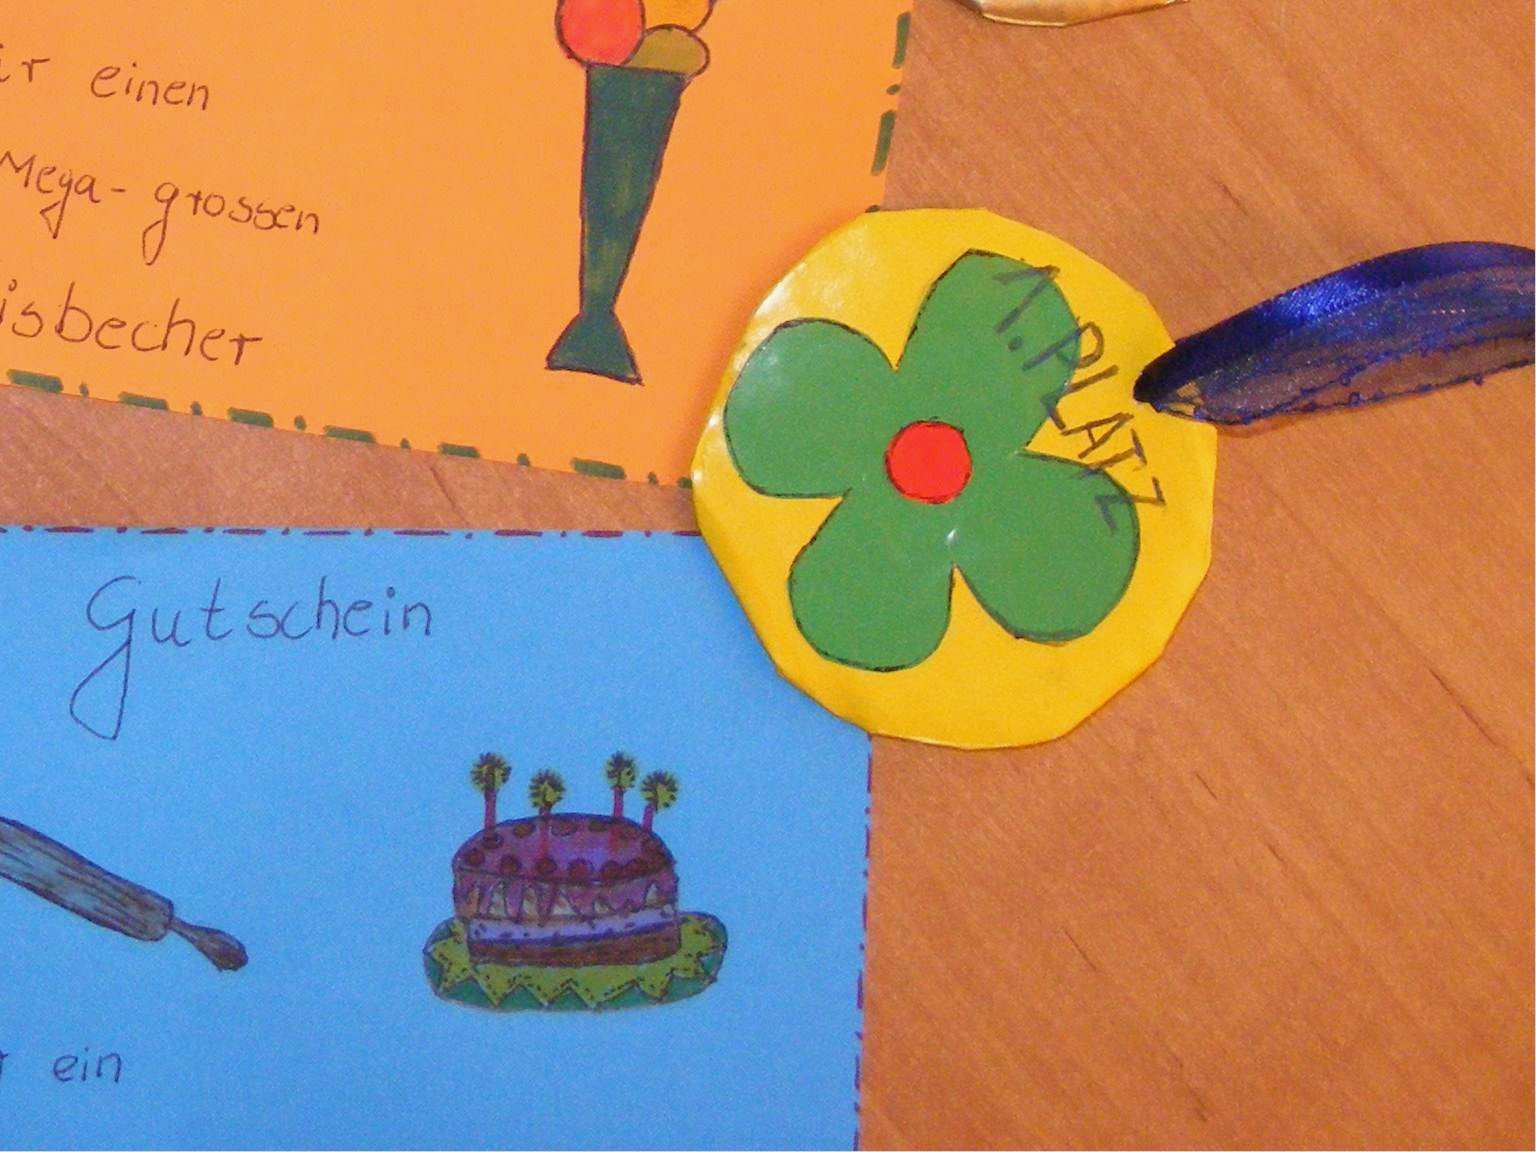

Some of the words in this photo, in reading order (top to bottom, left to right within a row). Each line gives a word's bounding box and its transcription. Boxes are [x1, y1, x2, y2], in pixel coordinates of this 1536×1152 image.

[88, 60, 211, 112] einen
[140, 179, 322, 266] grossen
[68, 574, 435, 741] Gutschein
[52, 1046, 123, 1084] ein
